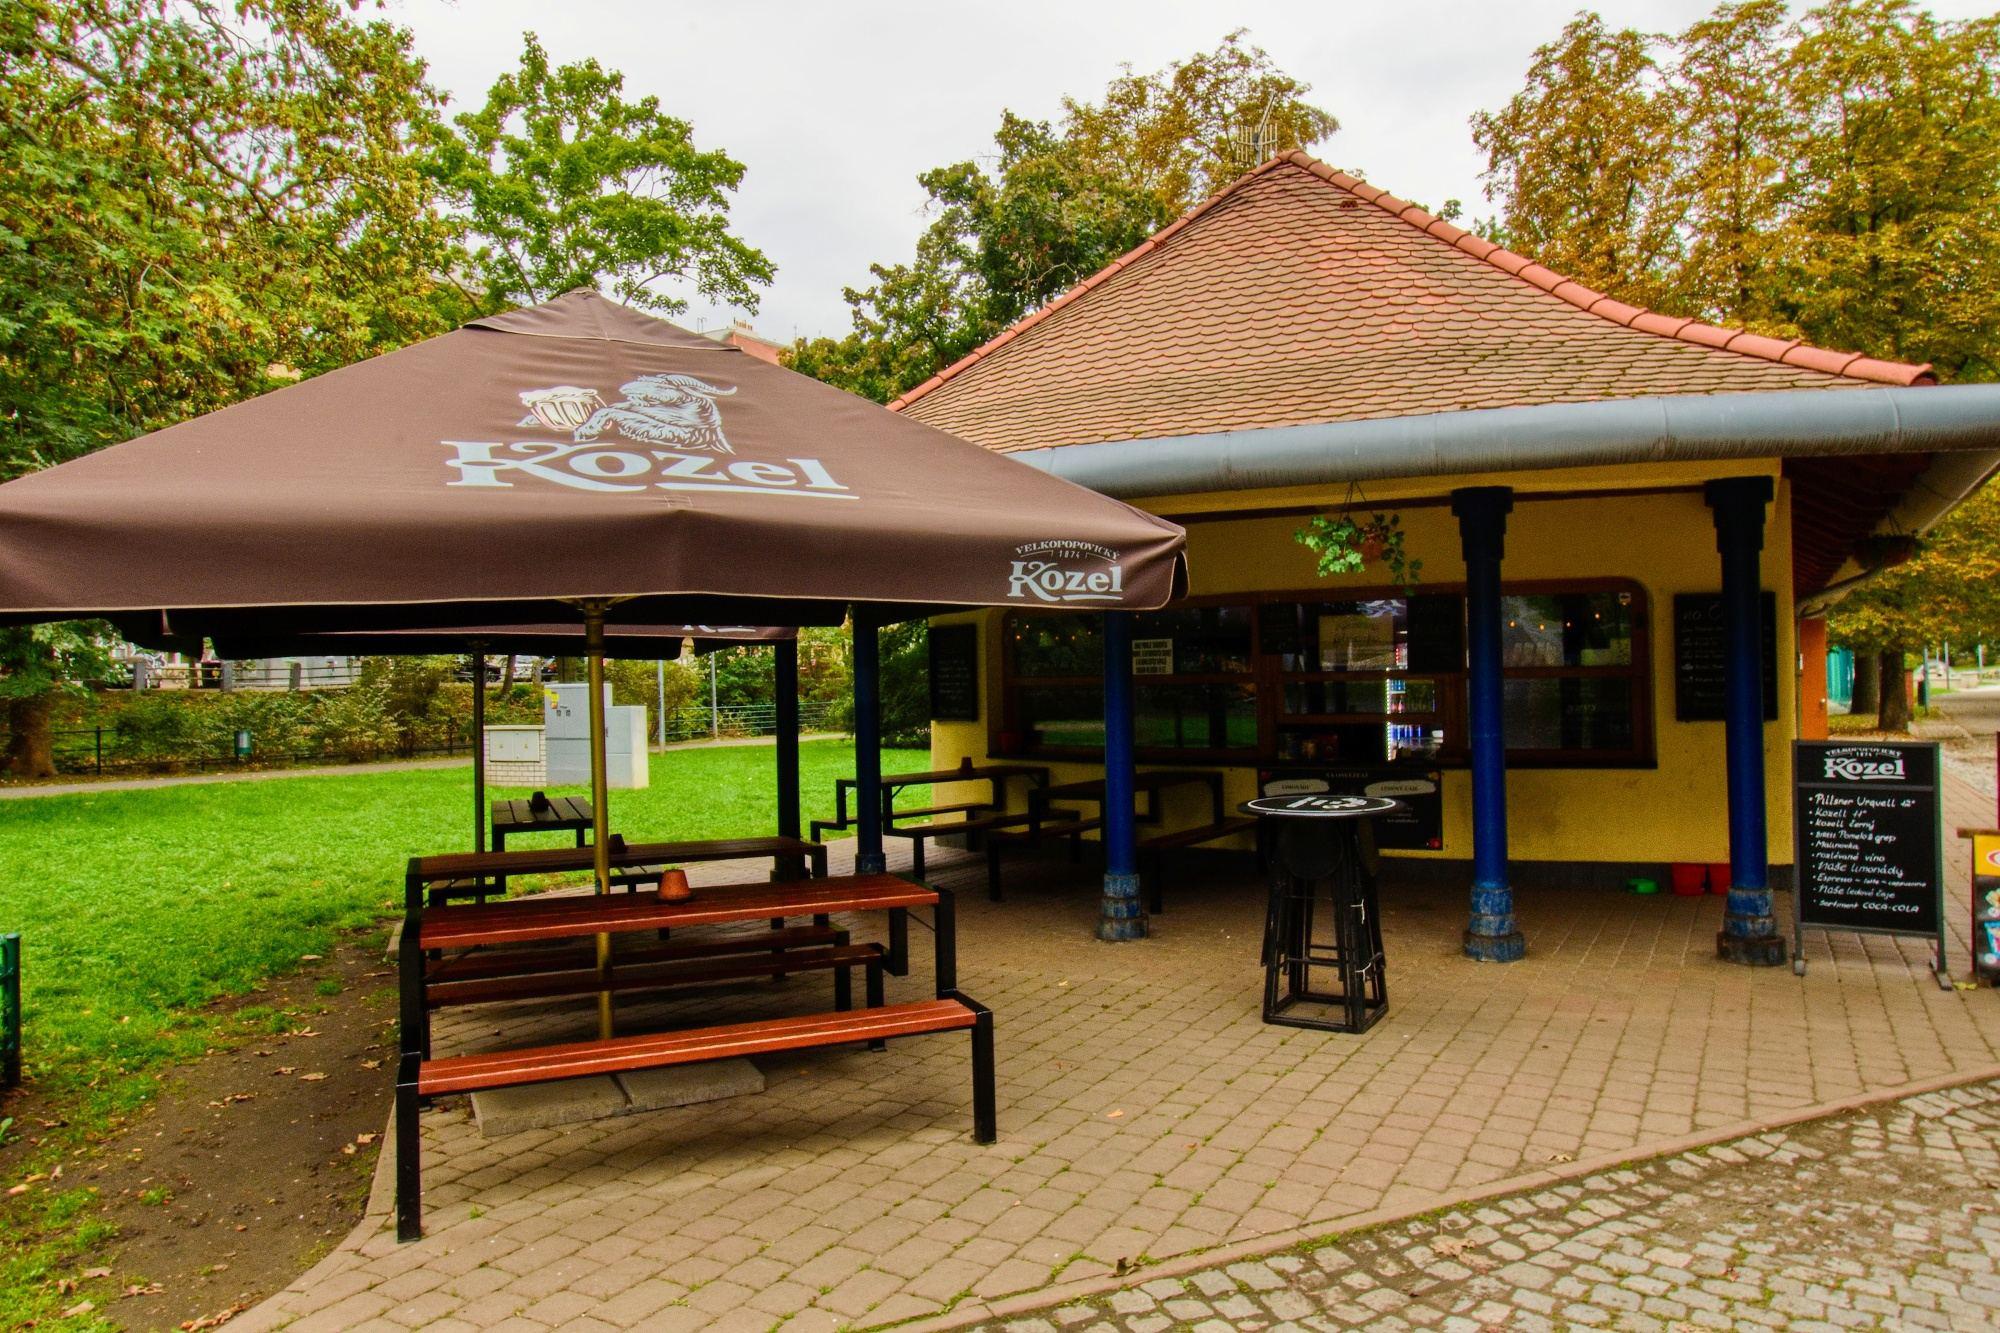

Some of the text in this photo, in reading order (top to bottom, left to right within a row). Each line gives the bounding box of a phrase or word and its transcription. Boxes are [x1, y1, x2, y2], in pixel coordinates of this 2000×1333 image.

[440, 440, 859, 499] Kozel
[1059, 550, 1080, 559] 1874
[1007, 560, 1123, 602] Kozel
[1823, 757, 1906, 780] Kozel
[1864, 853, 1886, 863] víno
[1850, 863, 1904, 879] limonády
[1862, 901, 1920, 913] COCA-COLA
